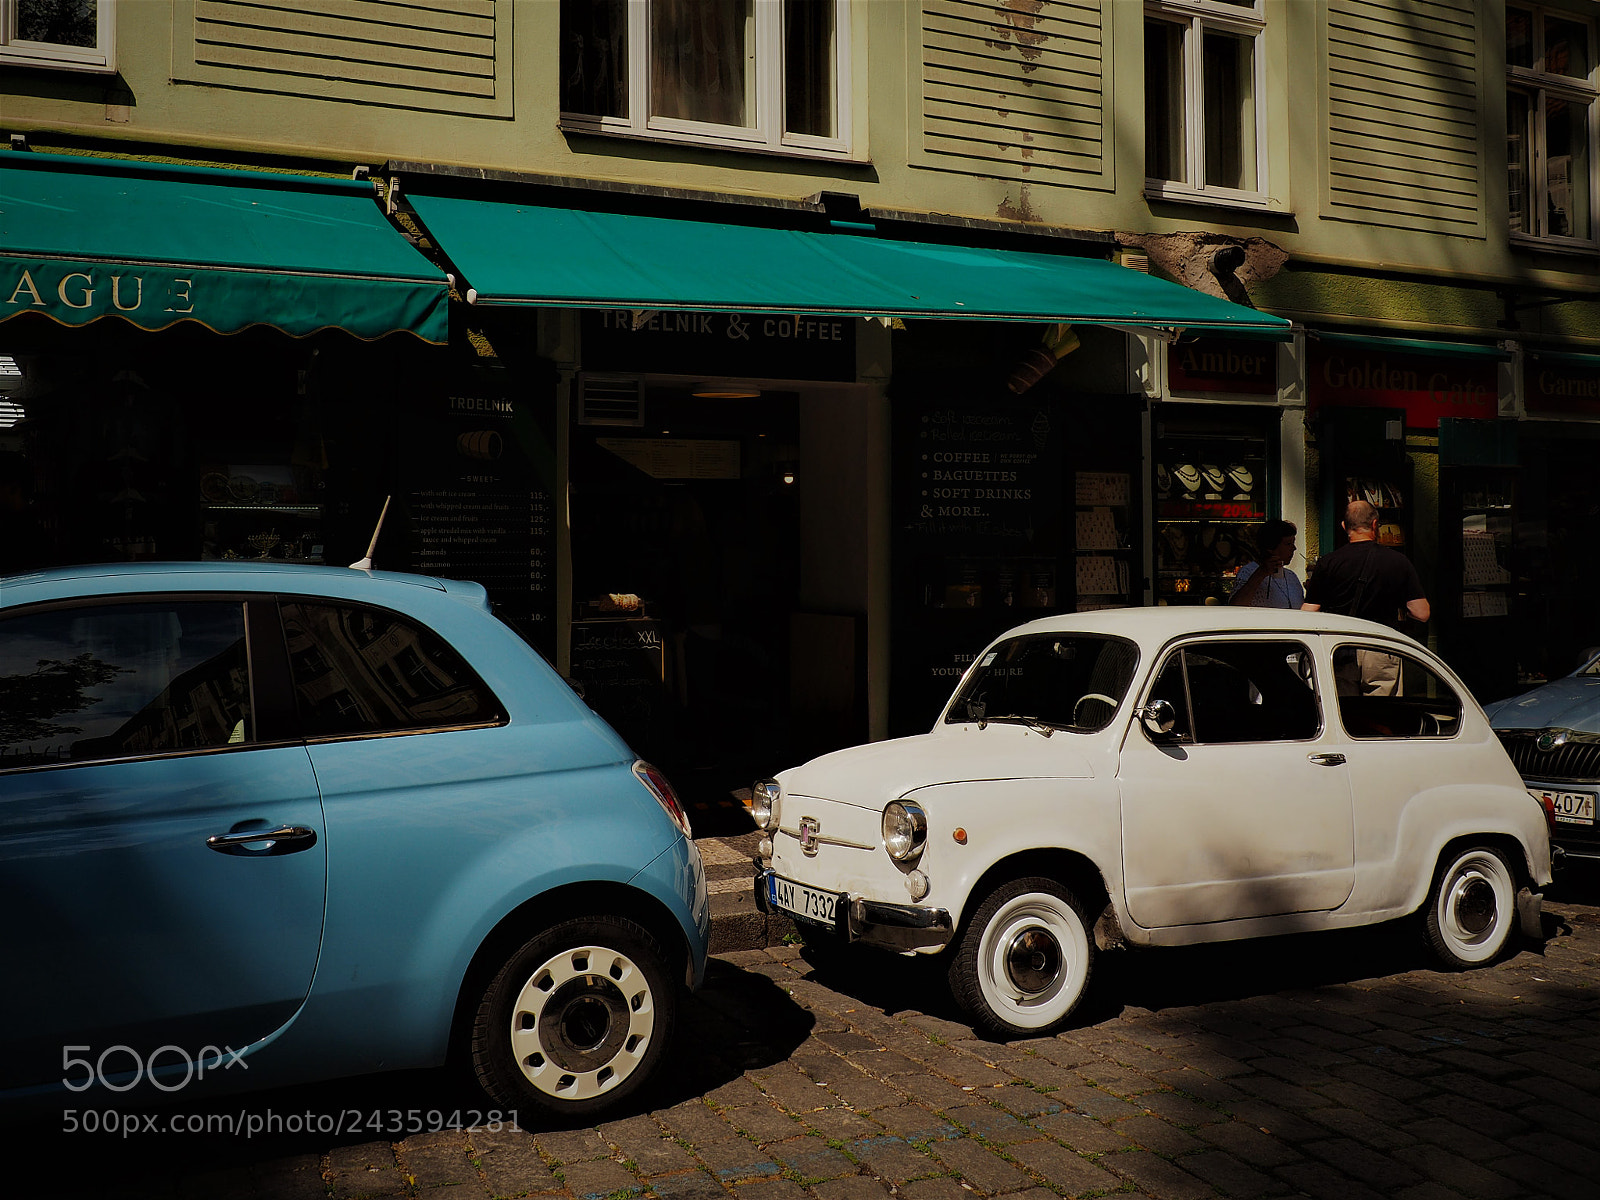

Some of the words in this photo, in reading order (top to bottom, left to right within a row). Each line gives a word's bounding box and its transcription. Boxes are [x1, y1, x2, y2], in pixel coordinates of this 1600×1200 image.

[6, 269, 194, 313] AGUE
[600, 309, 713, 334] TRELNÍK
[726, 313, 750, 341] &
[763, 318, 842, 341] COFFEE
[1179, 347, 1267, 375] Amber
[1323, 355, 1418, 392] Golden
[1428, 371, 1487, 406] Gate
[1538, 368, 1600, 398] Garne
[932, 453, 991, 463] COFFEE
[932, 470, 1017, 482] BAGUETTES
[932, 488, 970, 499] SOFT
[974, 489, 1032, 500] DRINKS
[920, 504, 934, 518] &
[938, 506, 990, 517] MORE..
[637, 630, 661, 644] XXL
[932, 668, 963, 676] YOUR
[1543, 793, 1584, 815] 407
[778, 882, 794, 908] 4AY
[803, 890, 836, 921] 7332
